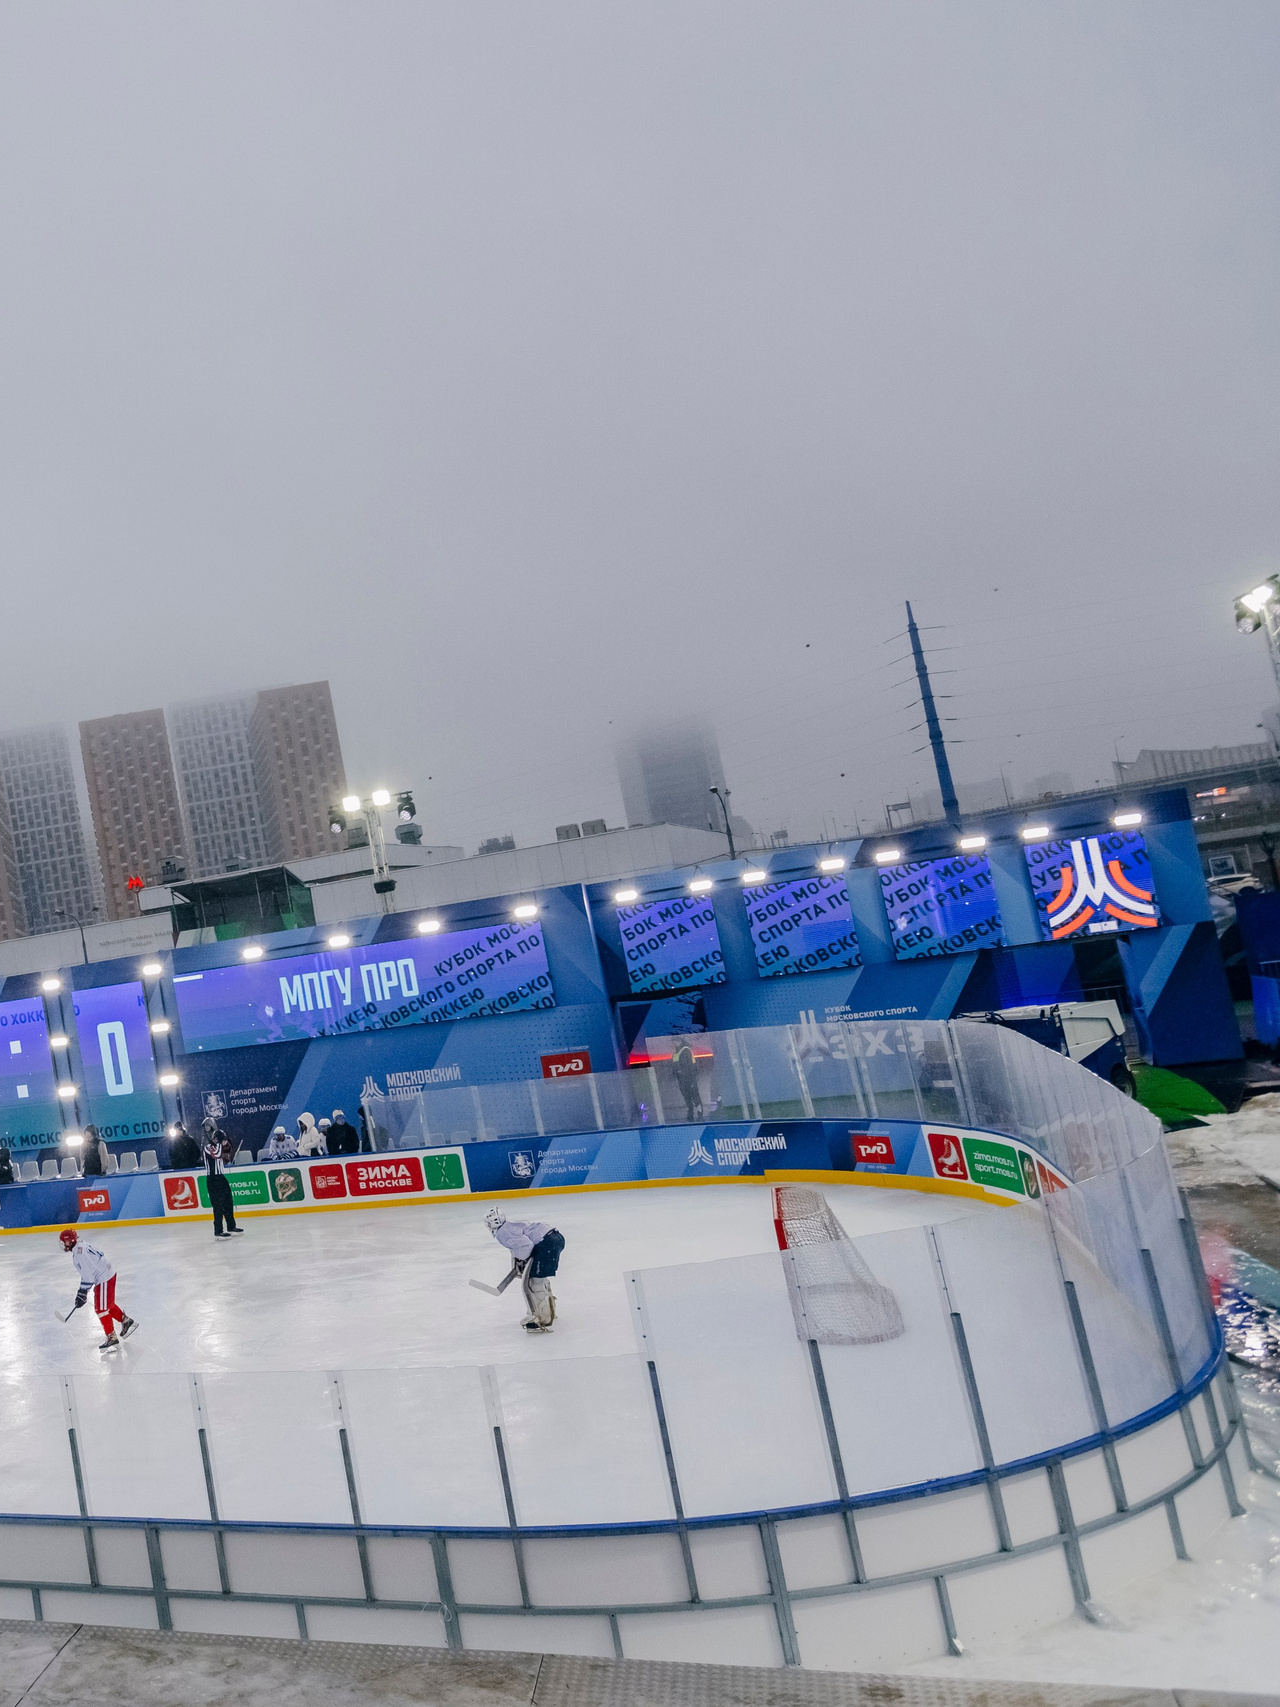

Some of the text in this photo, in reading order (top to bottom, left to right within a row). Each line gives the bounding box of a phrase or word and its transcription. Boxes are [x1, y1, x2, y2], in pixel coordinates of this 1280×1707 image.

[758, 904, 827, 943] СПОРТА
[627, 909, 714, 961] СПОРТА ПО
[434, 941, 486, 977] КУБОК
[457, 948, 517, 986] СПОРТА
[517, 934, 541, 954] ПО
[279, 957, 419, 1014] МПГУ ПРО
[824, 1004, 852, 1014] КУБОК
[826, 1006, 919, 1023] МОСКОВСКОГО СПОРТА
[97, 1021, 134, 1096] 0
[386, 1063, 462, 1088] МОСКОВСКИЙ
[229, 1085, 278, 1098] Департамент
[388, 1085, 425, 1104] СПОРТ
[230, 1097, 257, 1107] спорта
[232, 1102, 289, 1116] города Москвы
[714, 1133, 788, 1152] МОСКОВСКИЙ
[538, 1147, 587, 1158] Департамент
[716, 1150, 752, 1167] СПОРТ
[973, 1150, 1015, 1168] zima.mos.ru
[539, 1158, 566, 1167] спорта
[541, 1164, 599, 1175] города Москвы
[974, 1162, 1019, 1180] sport.mos.ru
[357, 1164, 411, 1181] ЗИМА
[359, 1178, 413, 1190] В МОСКВЕ
